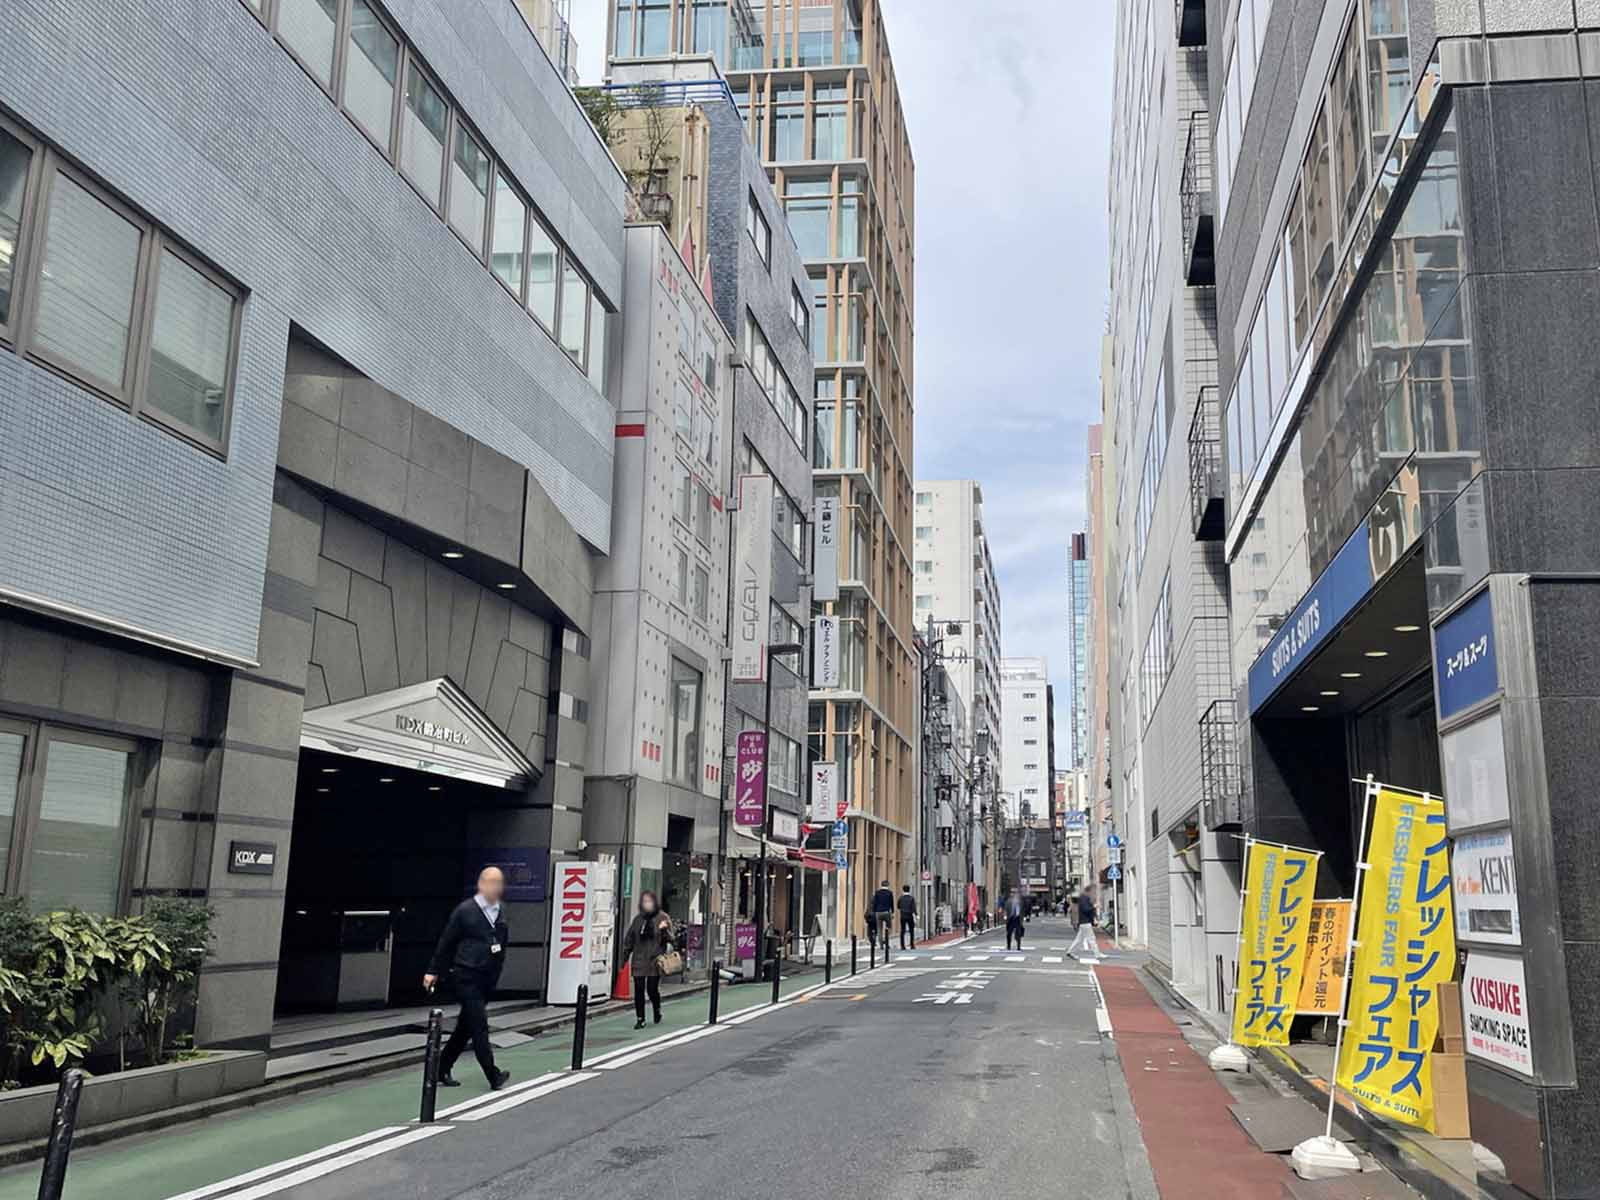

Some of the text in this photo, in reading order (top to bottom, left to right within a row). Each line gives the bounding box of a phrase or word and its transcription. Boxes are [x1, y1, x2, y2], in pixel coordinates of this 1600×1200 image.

[1272, 599, 1320, 678] SUITS & SUITS
[235, 850, 257, 864] KDX
[1380, 803, 1415, 968] FRESHERS FAIR
[559, 867, 588, 959] KIRIN
[1266, 859, 1307, 1033] フレッシャーズ
[1243, 959, 1267, 1029] フェア
[1352, 975, 1399, 1084] フェア
[1469, 1012, 1501, 1041] SMOKING
[1502, 1022, 1528, 1050] SPACE
[1352, 1086, 1422, 1120] SUITS & SUITS
